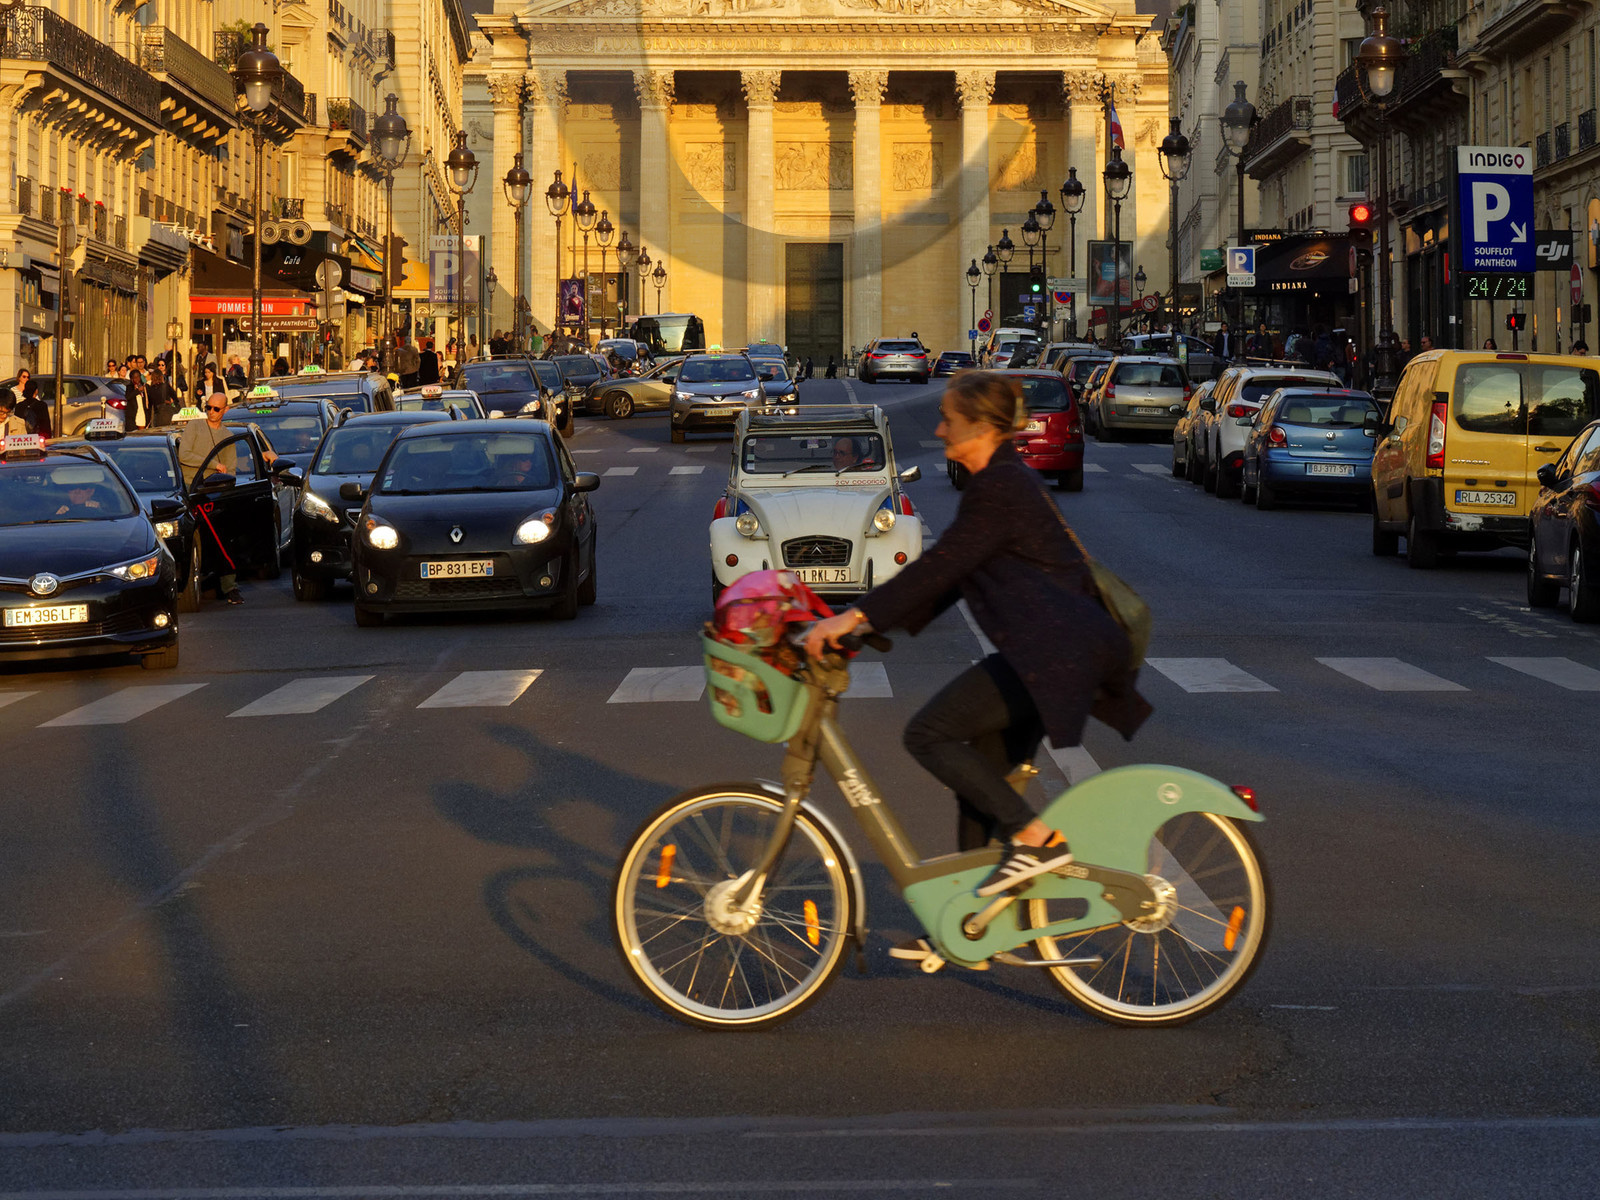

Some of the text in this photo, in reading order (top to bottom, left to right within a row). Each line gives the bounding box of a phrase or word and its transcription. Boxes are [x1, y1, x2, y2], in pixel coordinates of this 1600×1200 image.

[601, 38, 637, 50] AUX
[642, 38, 709, 50] GRANDS
[712, 38, 782, 50] HOMMES
[817, 38, 875, 50] PATRIE
[881, 38, 1025, 50] RECONNAISSANTE
[1470, 153, 1525, 169] INDIGO
[1472, 181, 1511, 242] P
[435, 239, 472, 248] INDIO
[1474, 247, 1514, 256] SOUFFLOT
[283, 255, 301, 265] Café
[1235, 253, 1247, 269] P
[1474, 257, 1517, 267] PANTHÉON
[435, 253, 460, 287] P
[1271, 282, 1307, 290] INDIANA
[217, 303, 246, 312] POMME
[261, 304, 274, 313] AIN
[1461, 492, 1514, 504] RLA 25342
[811, 570, 830, 582] RKL
[834, 569, 846, 581] 75
